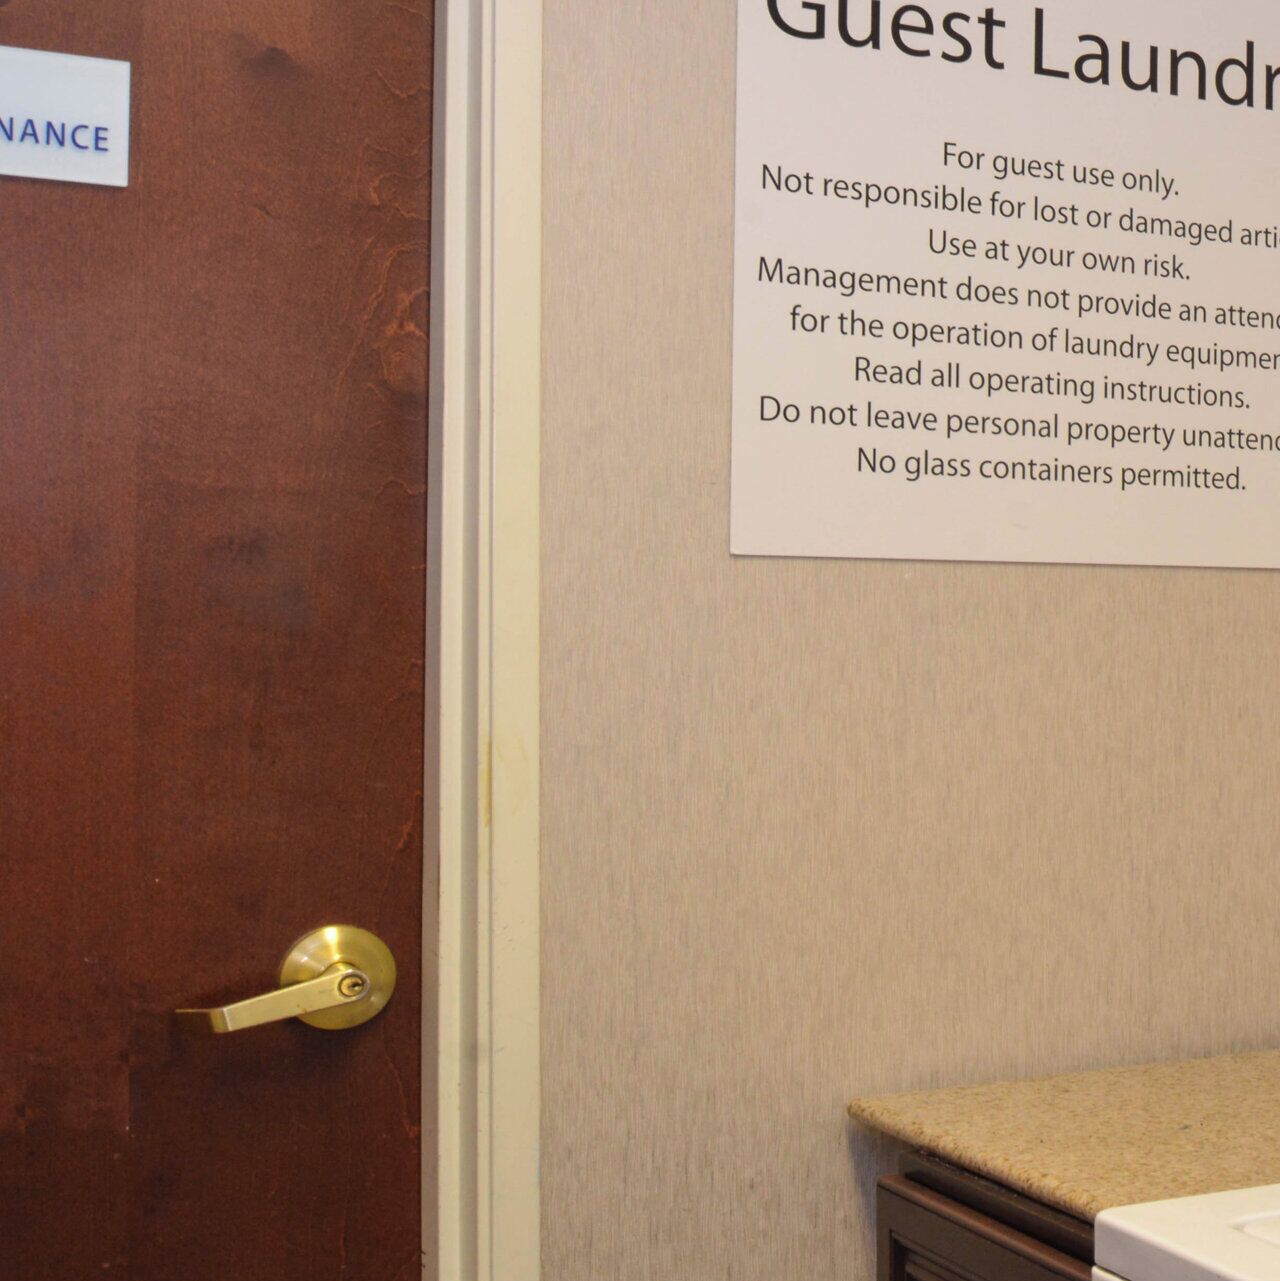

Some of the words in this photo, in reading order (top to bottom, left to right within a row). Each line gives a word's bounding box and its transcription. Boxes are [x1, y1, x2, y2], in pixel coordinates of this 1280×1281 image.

[766, 0, 1006, 71] Guest
[943, 141, 986, 171] For
[992, 154, 1065, 182] guest
[1072, 165, 1115, 188] use
[1121, 168, 1179, 201] only.
[762, 163, 814, 196] Not
[823, 178, 983, 215] responsible
[989, 190, 1027, 219] for
[1034, 195, 1079, 226] lost
[1086, 209, 1112, 229] or
[1118, 207, 1233, 246] damaged
[929, 228, 977, 258] Use
[984, 239, 1010, 262] at
[1016, 244, 1076, 270] your
[1081, 251, 1135, 275] own
[1144, 253, 1190, 281] risk.
[758, 256, 948, 300] Management
[955, 275, 1019, 306] does
[1027, 288, 1071, 311] not
[1078, 293, 1172, 320] provide
[1178, 303, 1207, 323] an
[789, 303, 831, 334] for
[837, 309, 885, 338] the
[892, 321, 1023, 350] operation
[1031, 326, 1059, 352] of
[1064, 327, 1160, 367] laundry
[855, 356, 922, 386] Read
[930, 361, 960, 389] all
[968, 371, 1095, 405] operating
[1103, 375, 1250, 409] instructions.
[759, 395, 801, 423] Do
[810, 404, 858, 427] not
[867, 400, 938, 432] leave
[946, 413, 1059, 439] personal
[1067, 421, 1176, 452] property
[857, 446, 897, 474] No
[904, 449, 972, 482] glass
[979, 457, 1113, 485] containers
[1121, 464, 1246, 492] permitted.
